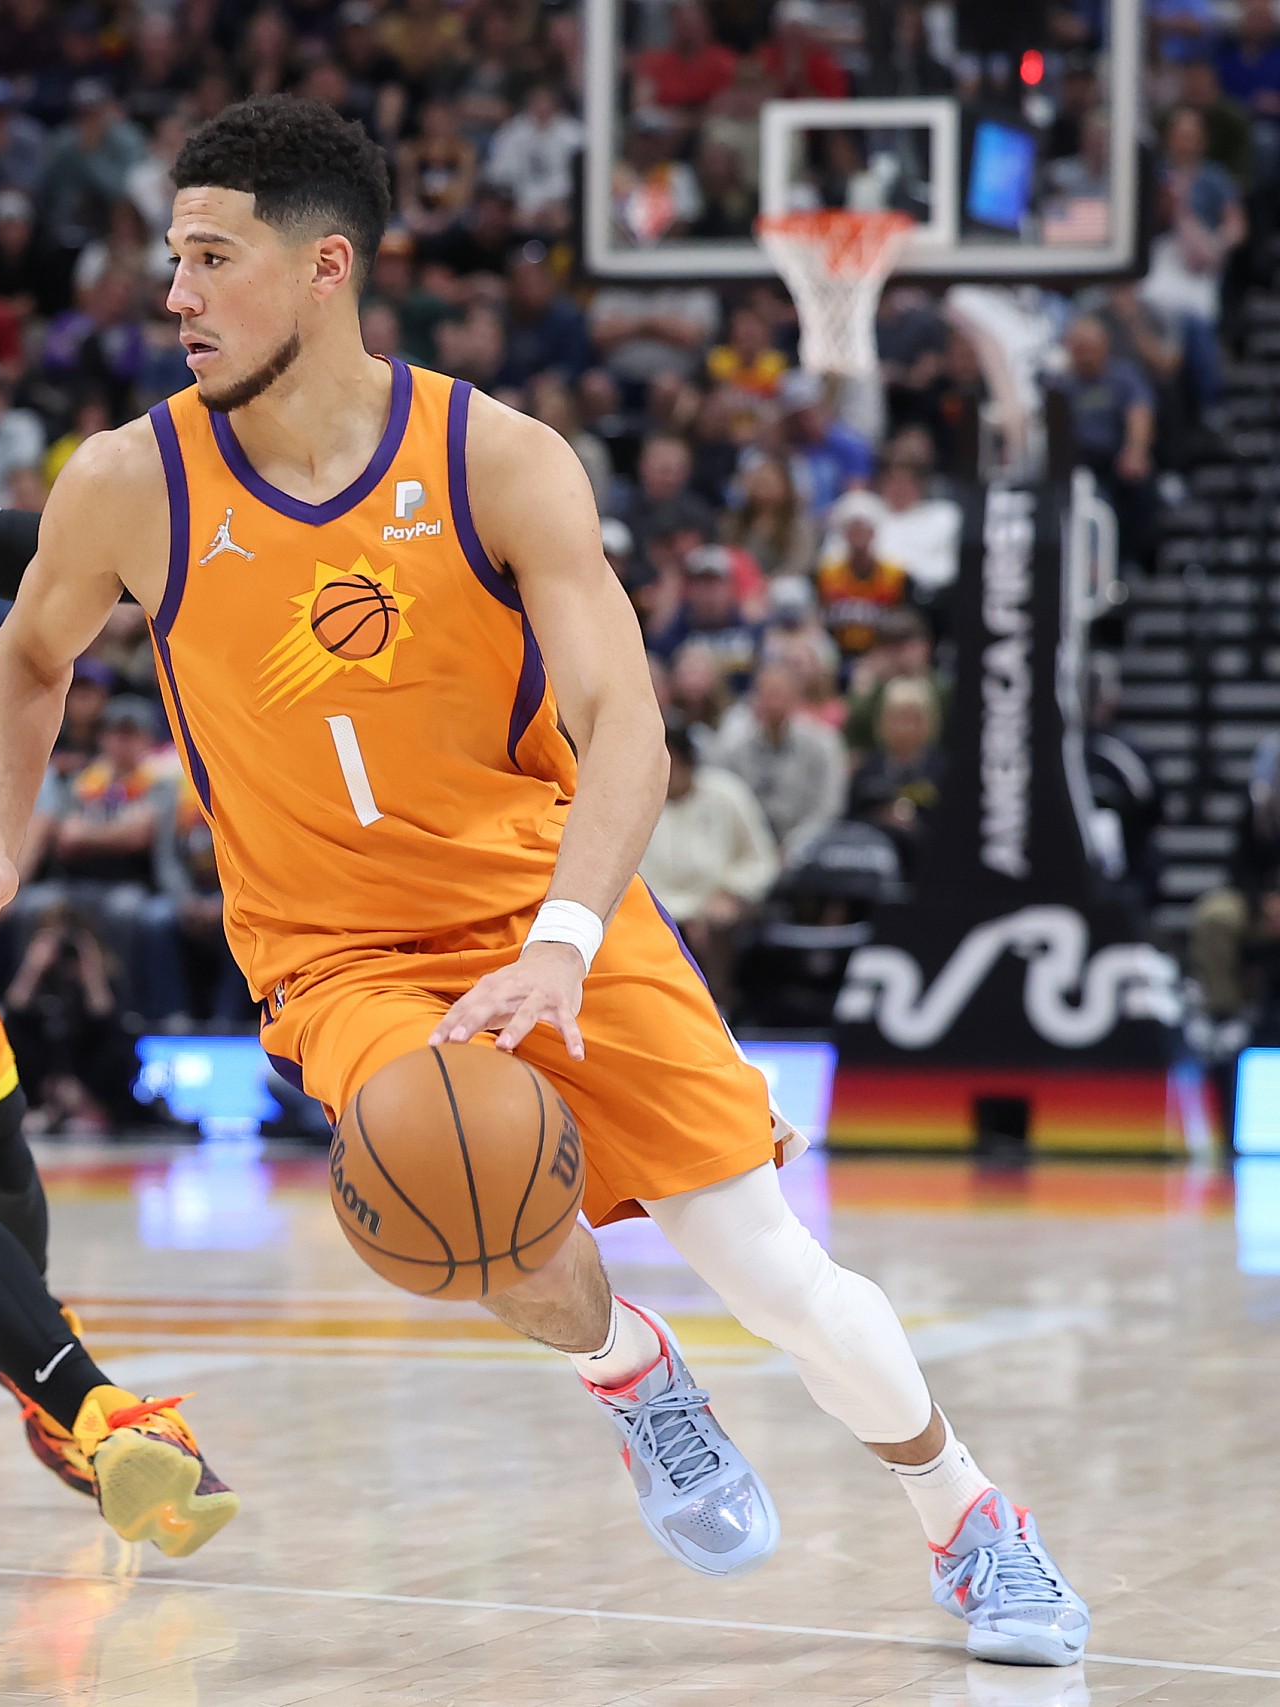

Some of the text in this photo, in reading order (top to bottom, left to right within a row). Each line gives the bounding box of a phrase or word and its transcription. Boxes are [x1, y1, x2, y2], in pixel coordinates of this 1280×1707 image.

[383, 519, 441, 541] PayPal
[323, 714, 385, 828] 1
[979, 635, 1034, 880] AMERICA
